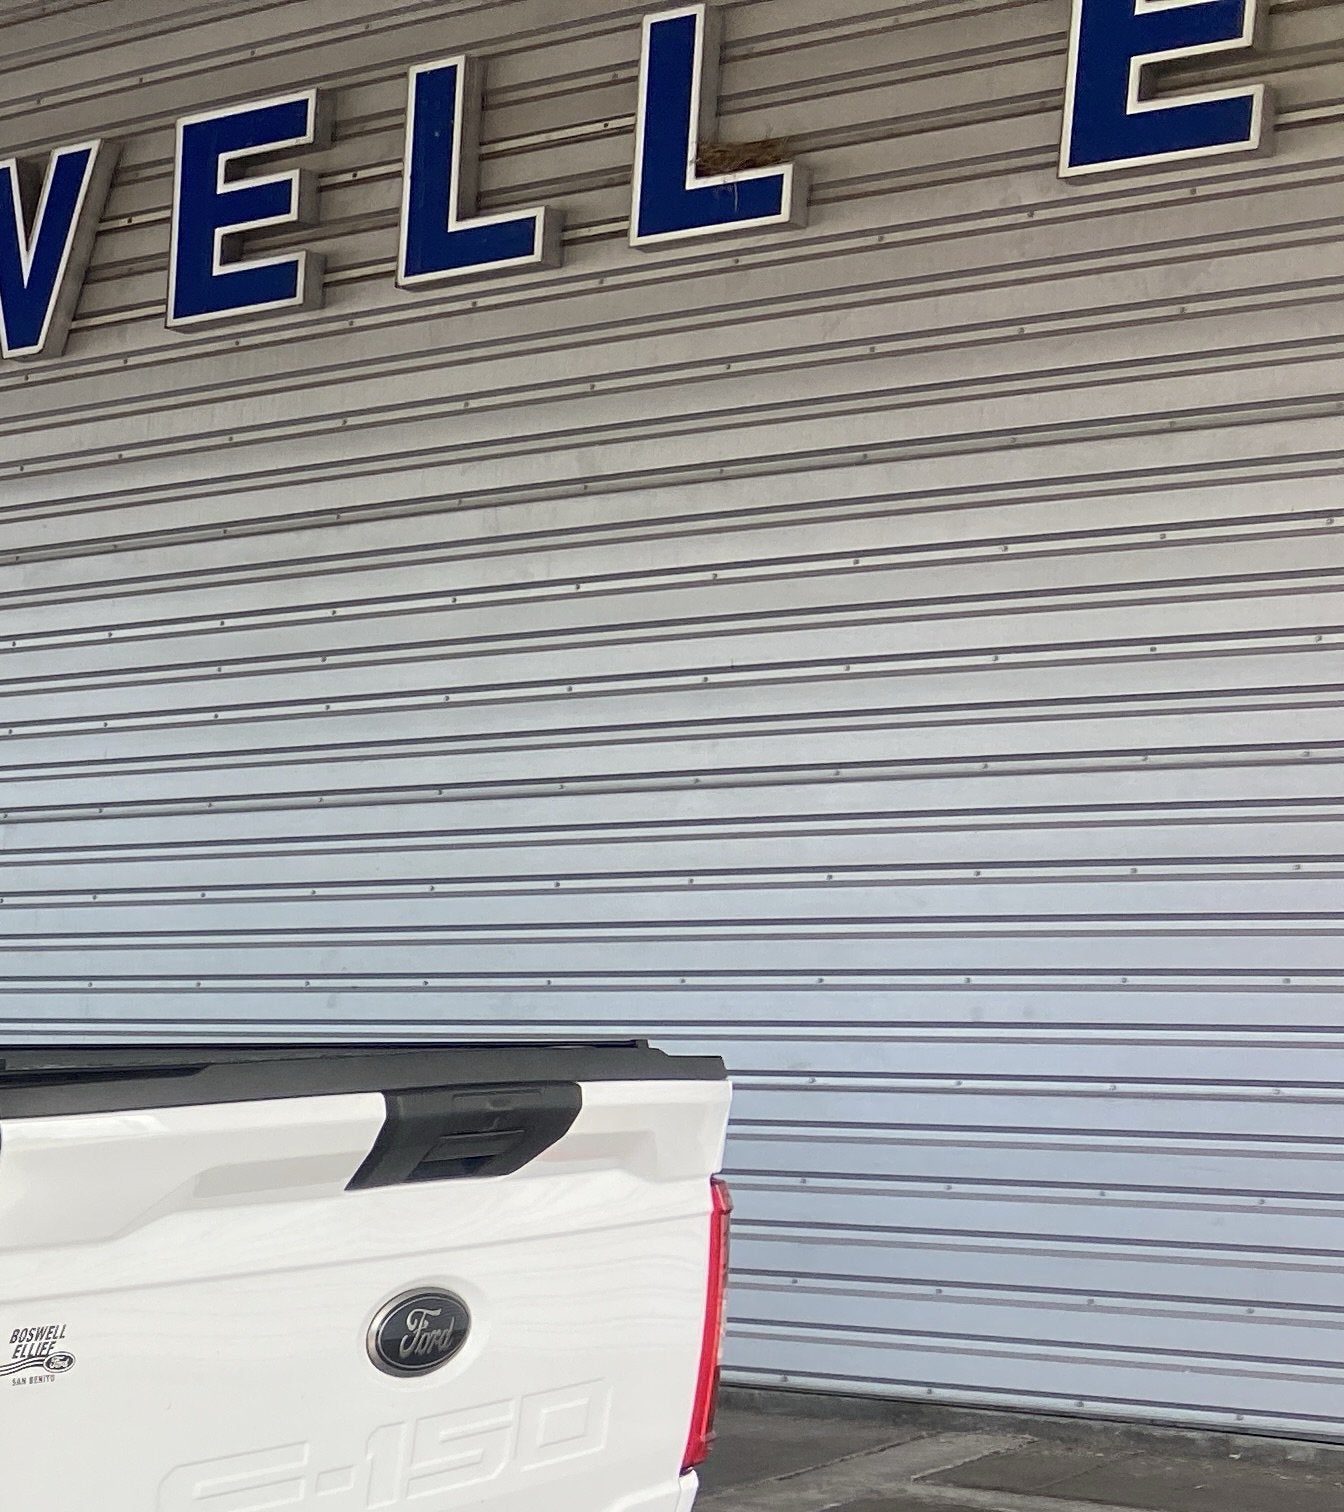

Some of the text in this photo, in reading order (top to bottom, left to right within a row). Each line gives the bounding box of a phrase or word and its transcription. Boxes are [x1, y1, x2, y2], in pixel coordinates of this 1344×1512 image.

[9, 1324, 66, 1344] BOSWELL
[398, 1307, 456, 1358] Ford
[12, 1341, 57, 1359] ELLIFF
[12, 1375, 55, 1386] SAN BENITO
